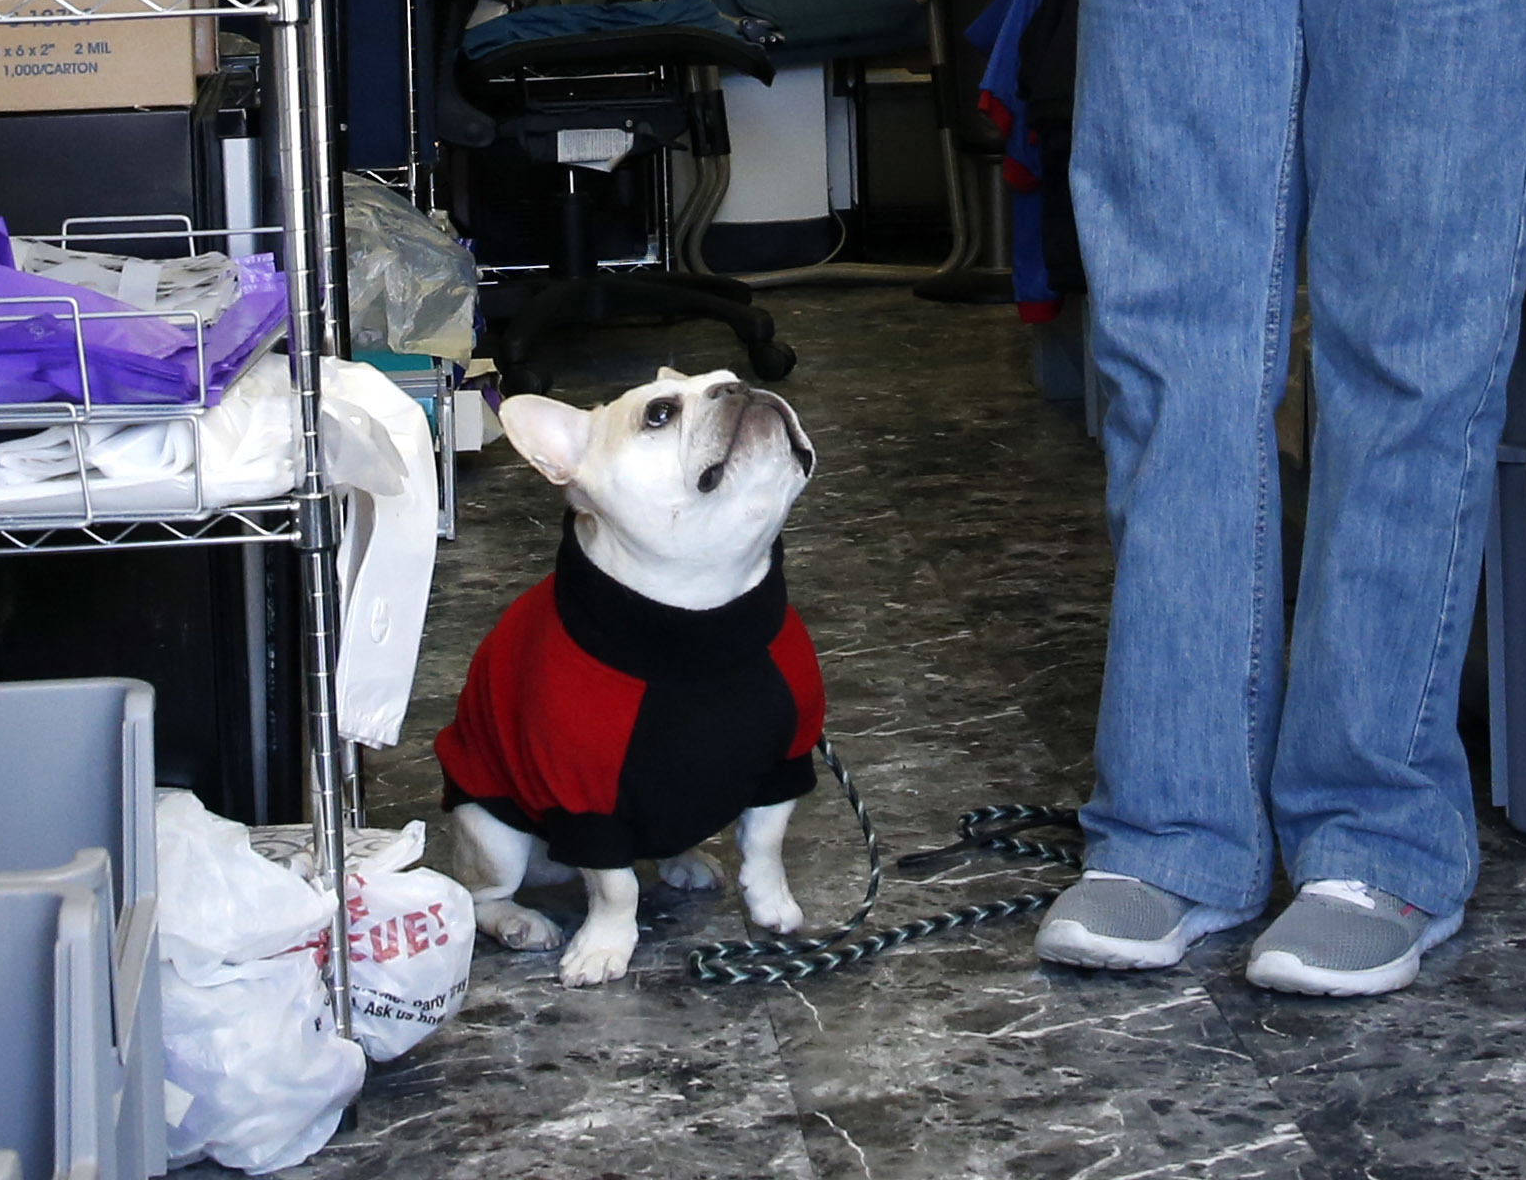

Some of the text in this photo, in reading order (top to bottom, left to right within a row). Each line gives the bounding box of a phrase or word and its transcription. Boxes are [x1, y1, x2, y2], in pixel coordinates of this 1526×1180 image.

[3, 48, 12, 58] x
[15, 44, 24, 57] 6
[28, 47, 37, 57] x
[74, 42, 84, 55] 2
[87, 41, 112, 56] MIL
[2, 61, 99, 78] 1,000/CARTON
[364, 1001, 393, 1020] Ask
[396, 1009, 414, 1020] us
